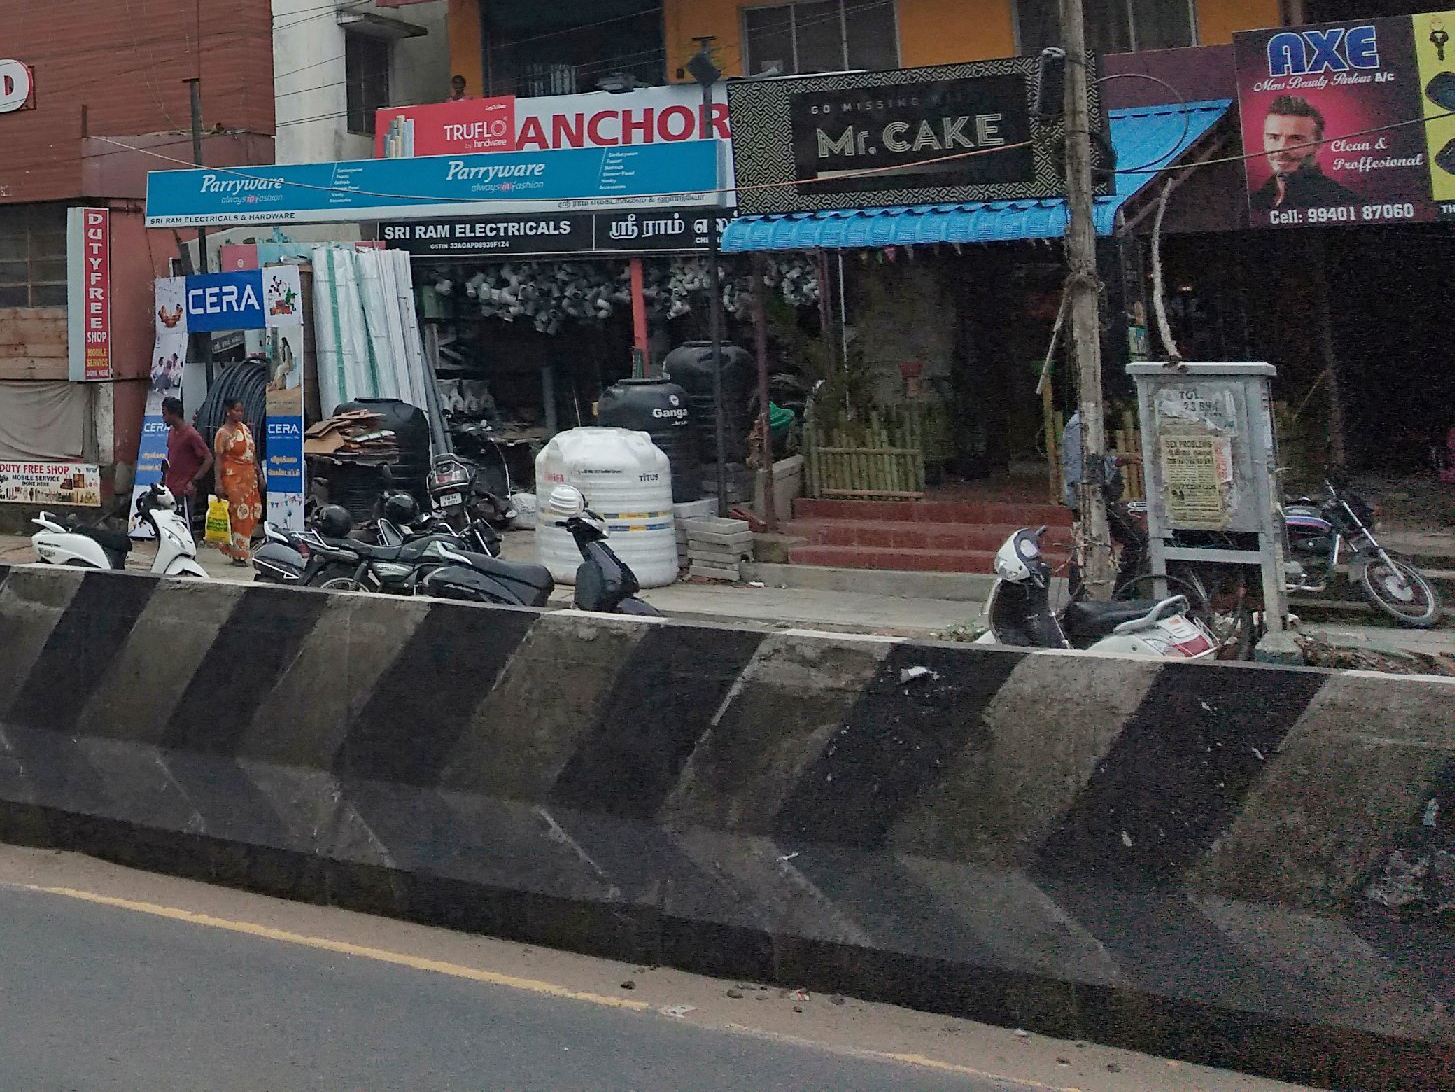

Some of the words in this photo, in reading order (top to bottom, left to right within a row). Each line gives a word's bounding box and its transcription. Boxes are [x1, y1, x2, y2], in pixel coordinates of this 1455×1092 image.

[1267, 25, 1379, 77] AXE
[1253, 78, 1285, 92] Mens
[1287, 74, 1328, 90] Beauty
[811, 104, 830, 115] GO
[843, 97, 919, 112] MISSING
[444, 117, 506, 141] TRUFLO
[516, 102, 732, 150] ANCHOR
[816, 125, 877, 158] Mr.
[882, 114, 1004, 153] CAKE
[1330, 139, 1370, 152] Clean
[1374, 137, 1388, 150] &
[446, 160, 545, 181] Parryware
[1333, 153, 1424, 172] Proffesional
[200, 174, 284, 193] Parryware
[471, 183, 499, 193] always
[511, 181, 544, 192] fashion
[165, 216, 182, 224] RAM
[185, 214, 239, 223] ELECTRICALS
[248, 212, 296, 220] HARDWARE
[1270, 208, 1303, 224] Cell:
[1308, 206, 1356, 223] 99401
[1362, 203, 1414, 220] 87060
[385, 225, 410, 239] SRI
[415, 224, 446, 238] RAM
[455, 220, 571, 237] ELECTRICALS
[642, 213, 685, 237] ராம்
[188, 284, 260, 315] CERA
[87, 331, 106, 343] SHOP
[652, 408, 688, 419] Ganga
[144, 422, 170, 433] CERA
[267, 423, 299, 434] CERA
[0, 463, 21, 473] DUTY
[23, 464, 44, 474] FREE
[46, 465, 70, 475] SHOP
